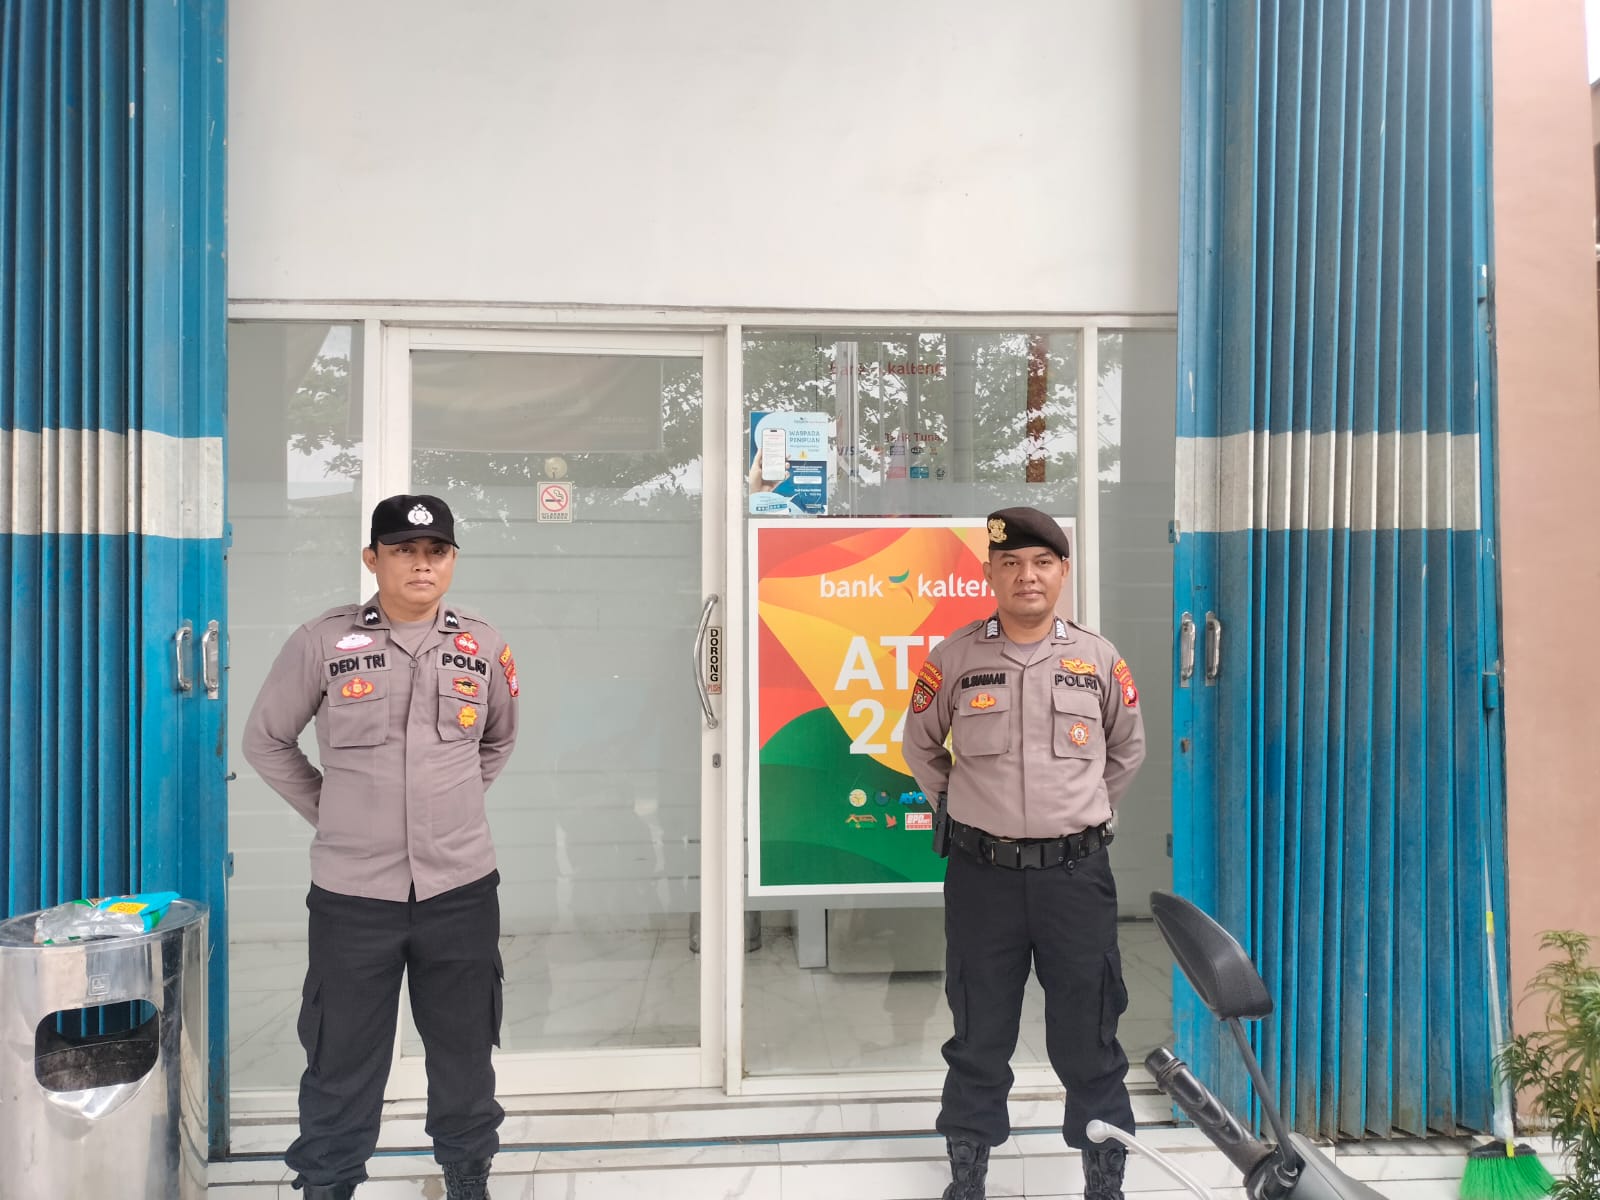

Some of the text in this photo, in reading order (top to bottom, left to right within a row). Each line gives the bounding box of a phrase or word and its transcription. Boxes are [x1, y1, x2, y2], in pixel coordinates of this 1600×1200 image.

[820, 573, 996, 598] bank kalten
[329, 653, 386, 677] DEDI TRI
[442, 652, 487, 675] POLRI
[710, 629, 719, 682] DORONG
[834, 635, 945, 691] AT
[1054, 674, 1098, 690] POLRI
